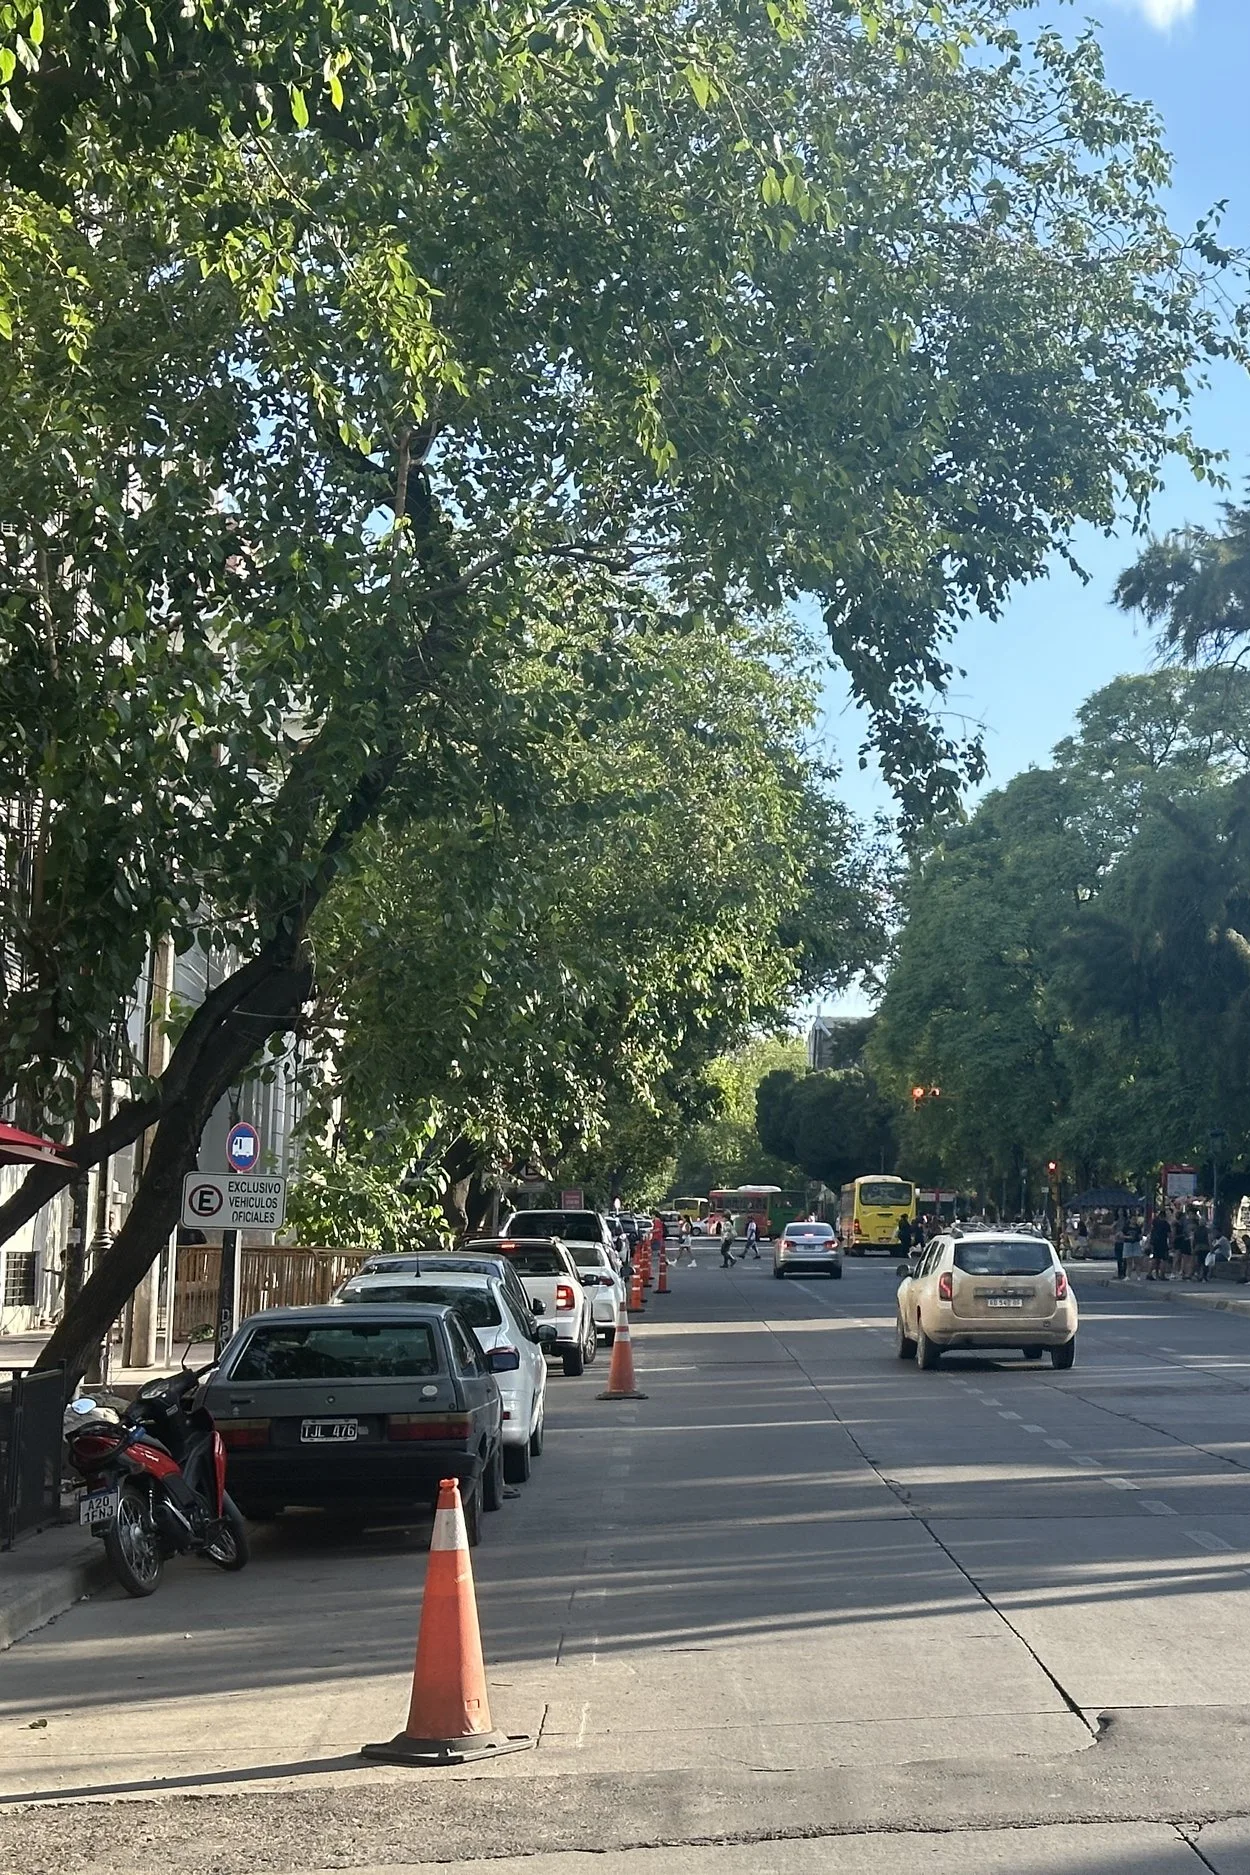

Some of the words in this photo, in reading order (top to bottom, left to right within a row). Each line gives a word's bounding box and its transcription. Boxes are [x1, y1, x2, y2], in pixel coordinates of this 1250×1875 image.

[228, 1181, 281, 1194] EXCLUSIVO
[198, 1189, 214, 1212] E
[229, 1196, 278, 1209] VEHICULOS
[232, 1211, 275, 1223] OFICIALES
[304, 1425, 325, 1437] TJL
[333, 1424, 355, 1437] 476
